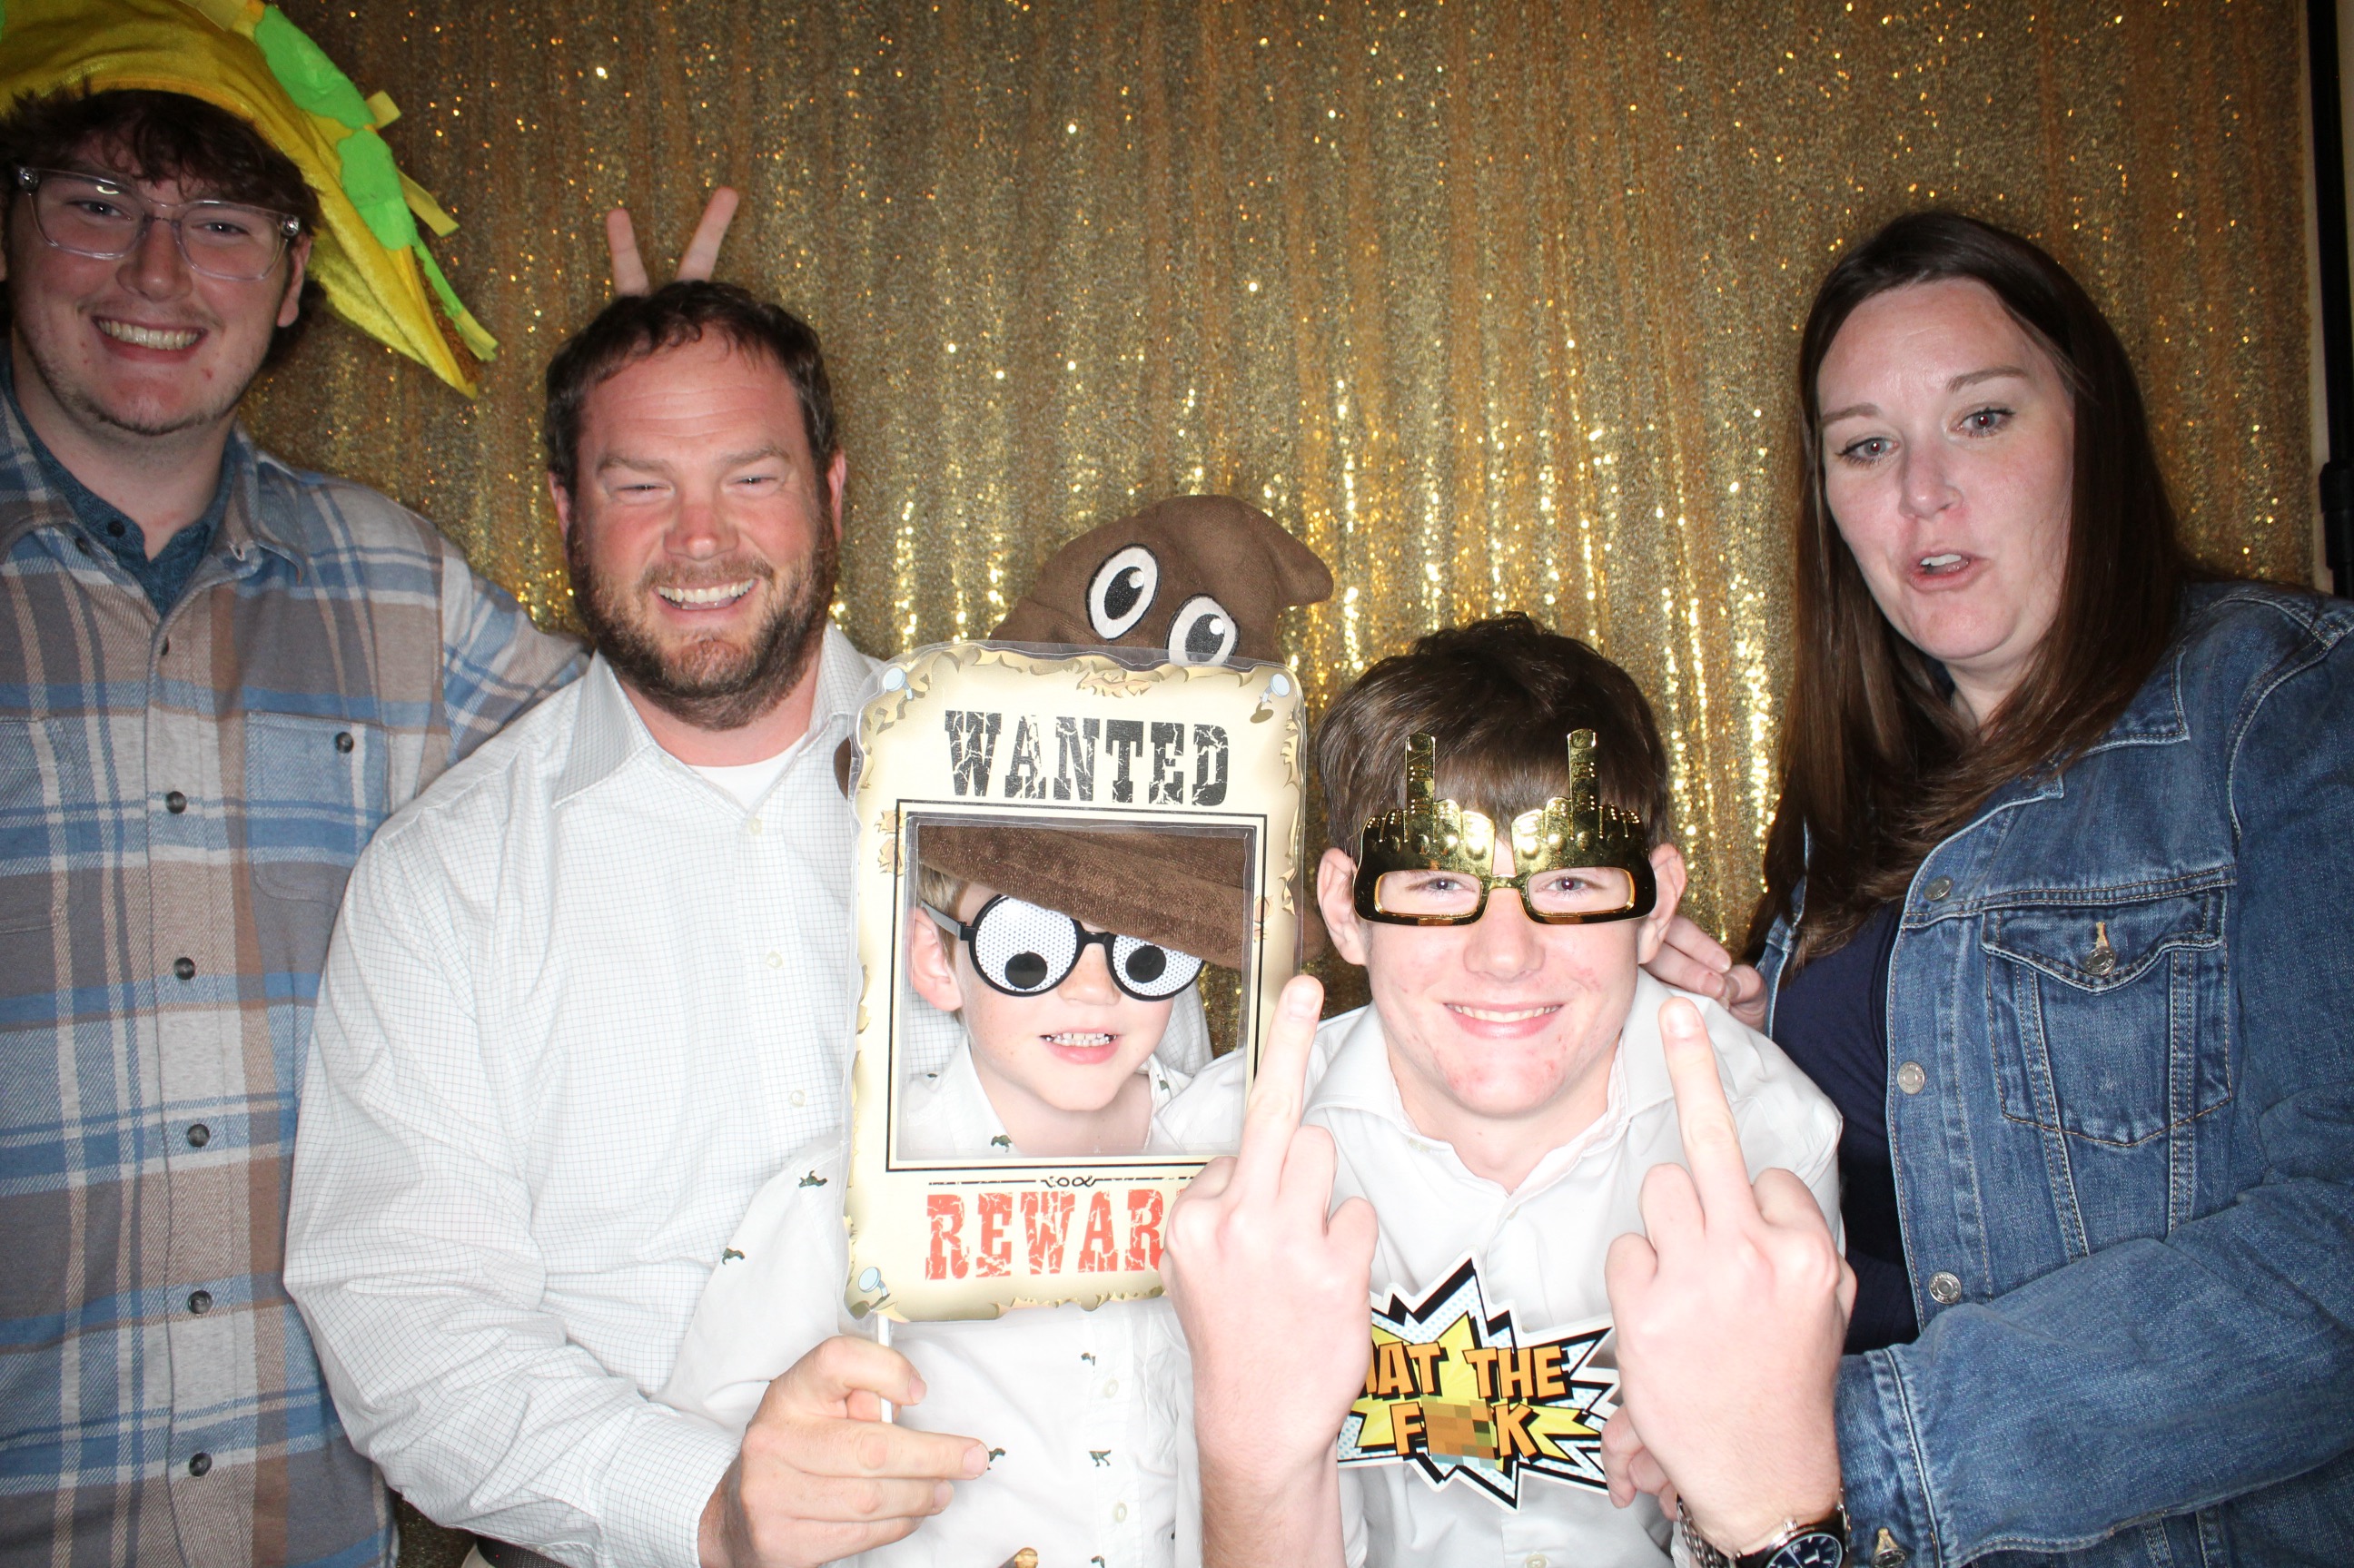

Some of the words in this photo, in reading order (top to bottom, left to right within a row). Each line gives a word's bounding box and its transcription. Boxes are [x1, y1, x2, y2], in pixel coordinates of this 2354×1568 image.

[945, 711, 1230, 806] WANTED
[925, 1188, 1186, 1281] REWAR
[1462, 1346, 1567, 1399] THE
[1390, 1402, 1538, 1459] FK
